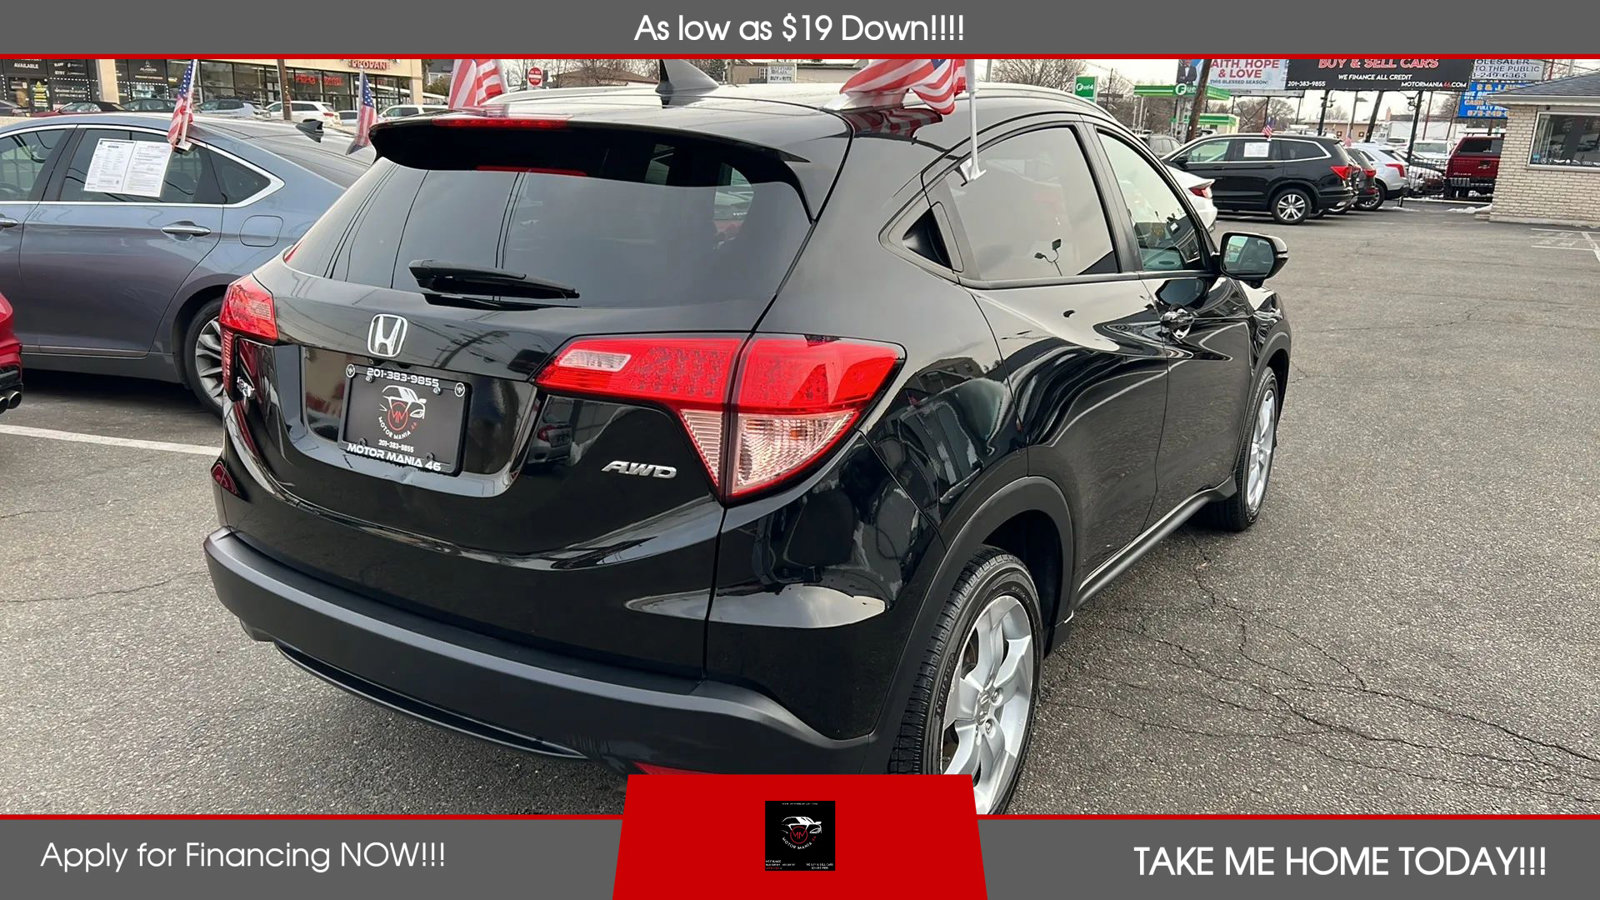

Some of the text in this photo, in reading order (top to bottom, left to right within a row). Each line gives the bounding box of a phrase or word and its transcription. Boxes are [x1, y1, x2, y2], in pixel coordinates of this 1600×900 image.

[1210, 58, 1280, 69] AITH, HOPE
[1318, 58, 1439, 68] BUY & SELL CARS
[1218, 69, 1262, 78] & LOVE
[366, 367, 440, 387] 201-383-9855
[378, 416, 393, 438] MOTOR
[393, 430, 411, 440] MANIA
[346, 443, 442, 472] MOTOR MANIA 46
[601, 460, 677, 479] AWD
